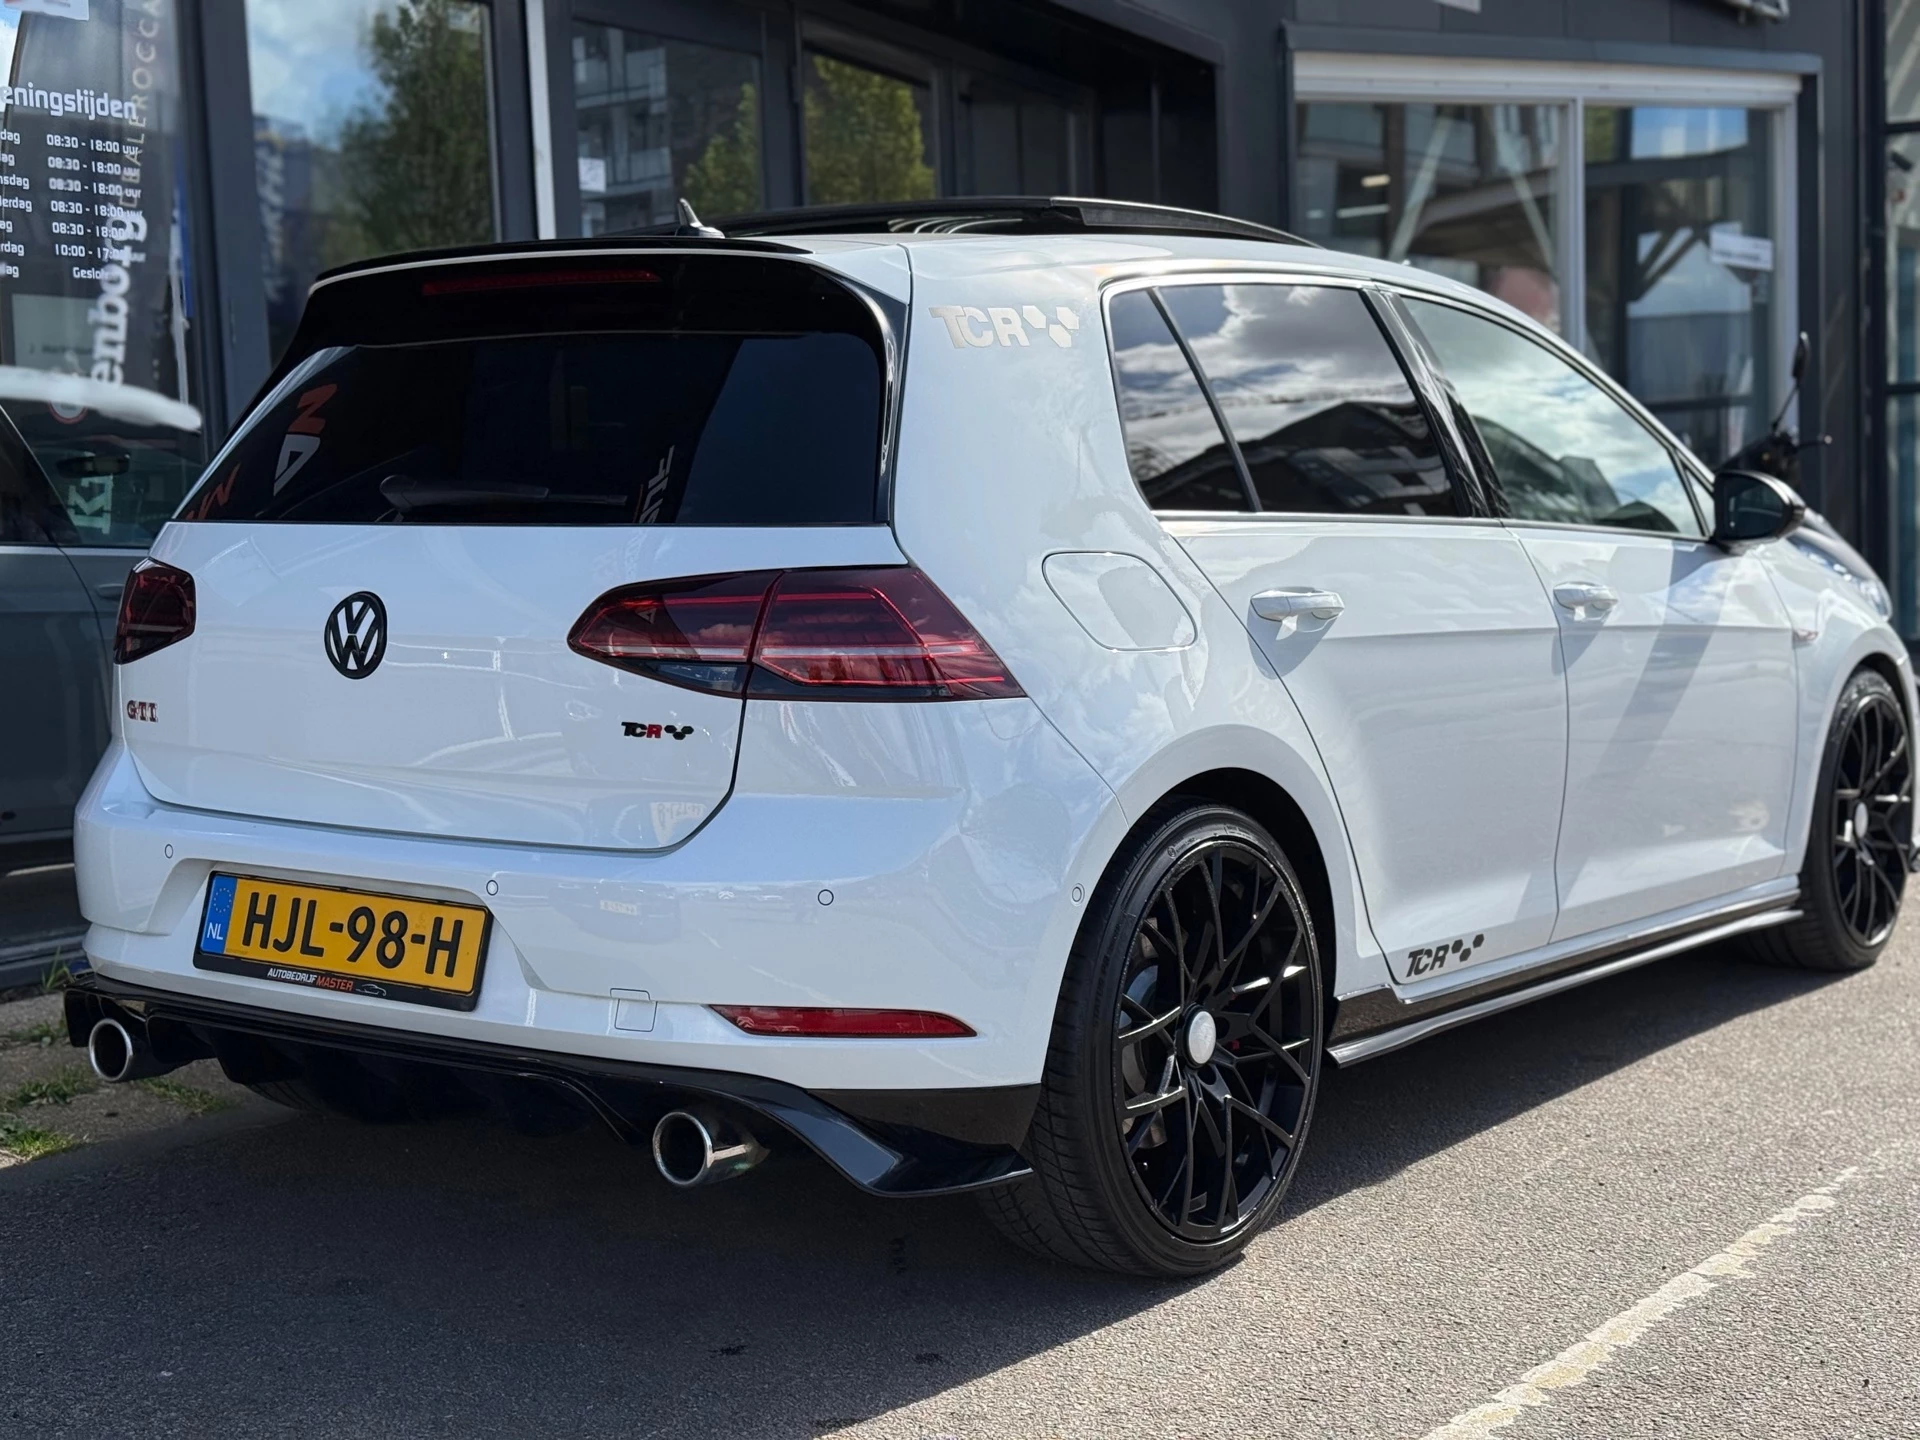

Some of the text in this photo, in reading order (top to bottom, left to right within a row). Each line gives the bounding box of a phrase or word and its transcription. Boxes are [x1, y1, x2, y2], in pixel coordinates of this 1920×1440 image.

[47, 134, 78, 148] 08:30
[90, 139, 119, 153] 18:00
[122, 145, 139, 155] uur
[0, 153, 15, 166] ag
[48, 156, 80, 171] 08:30
[92, 161, 121, 175] 18:00
[49, 177, 81, 192] 08:30
[93, 182, 122, 196] 18:00
[125, 188, 141, 198] uur
[0, 196, 32, 213] erdag
[51, 200, 83, 214] 08:30
[94, 204, 124, 218] 18:00
[52, 222, 84, 236] 08:30
[96, 226, 125, 239] 18:00
[55, 244, 85, 258] 10:00
[929, 305, 1030, 348] TCR
[126, 700, 158, 722] GTI
[621, 721, 663, 739] TCR
[206, 922, 224, 941] NL
[242, 892, 464, 978] HJL-98-H
[1406, 944, 1450, 978] TCR
[267, 967, 353, 991] AUTOBEDRIJF MASTER
